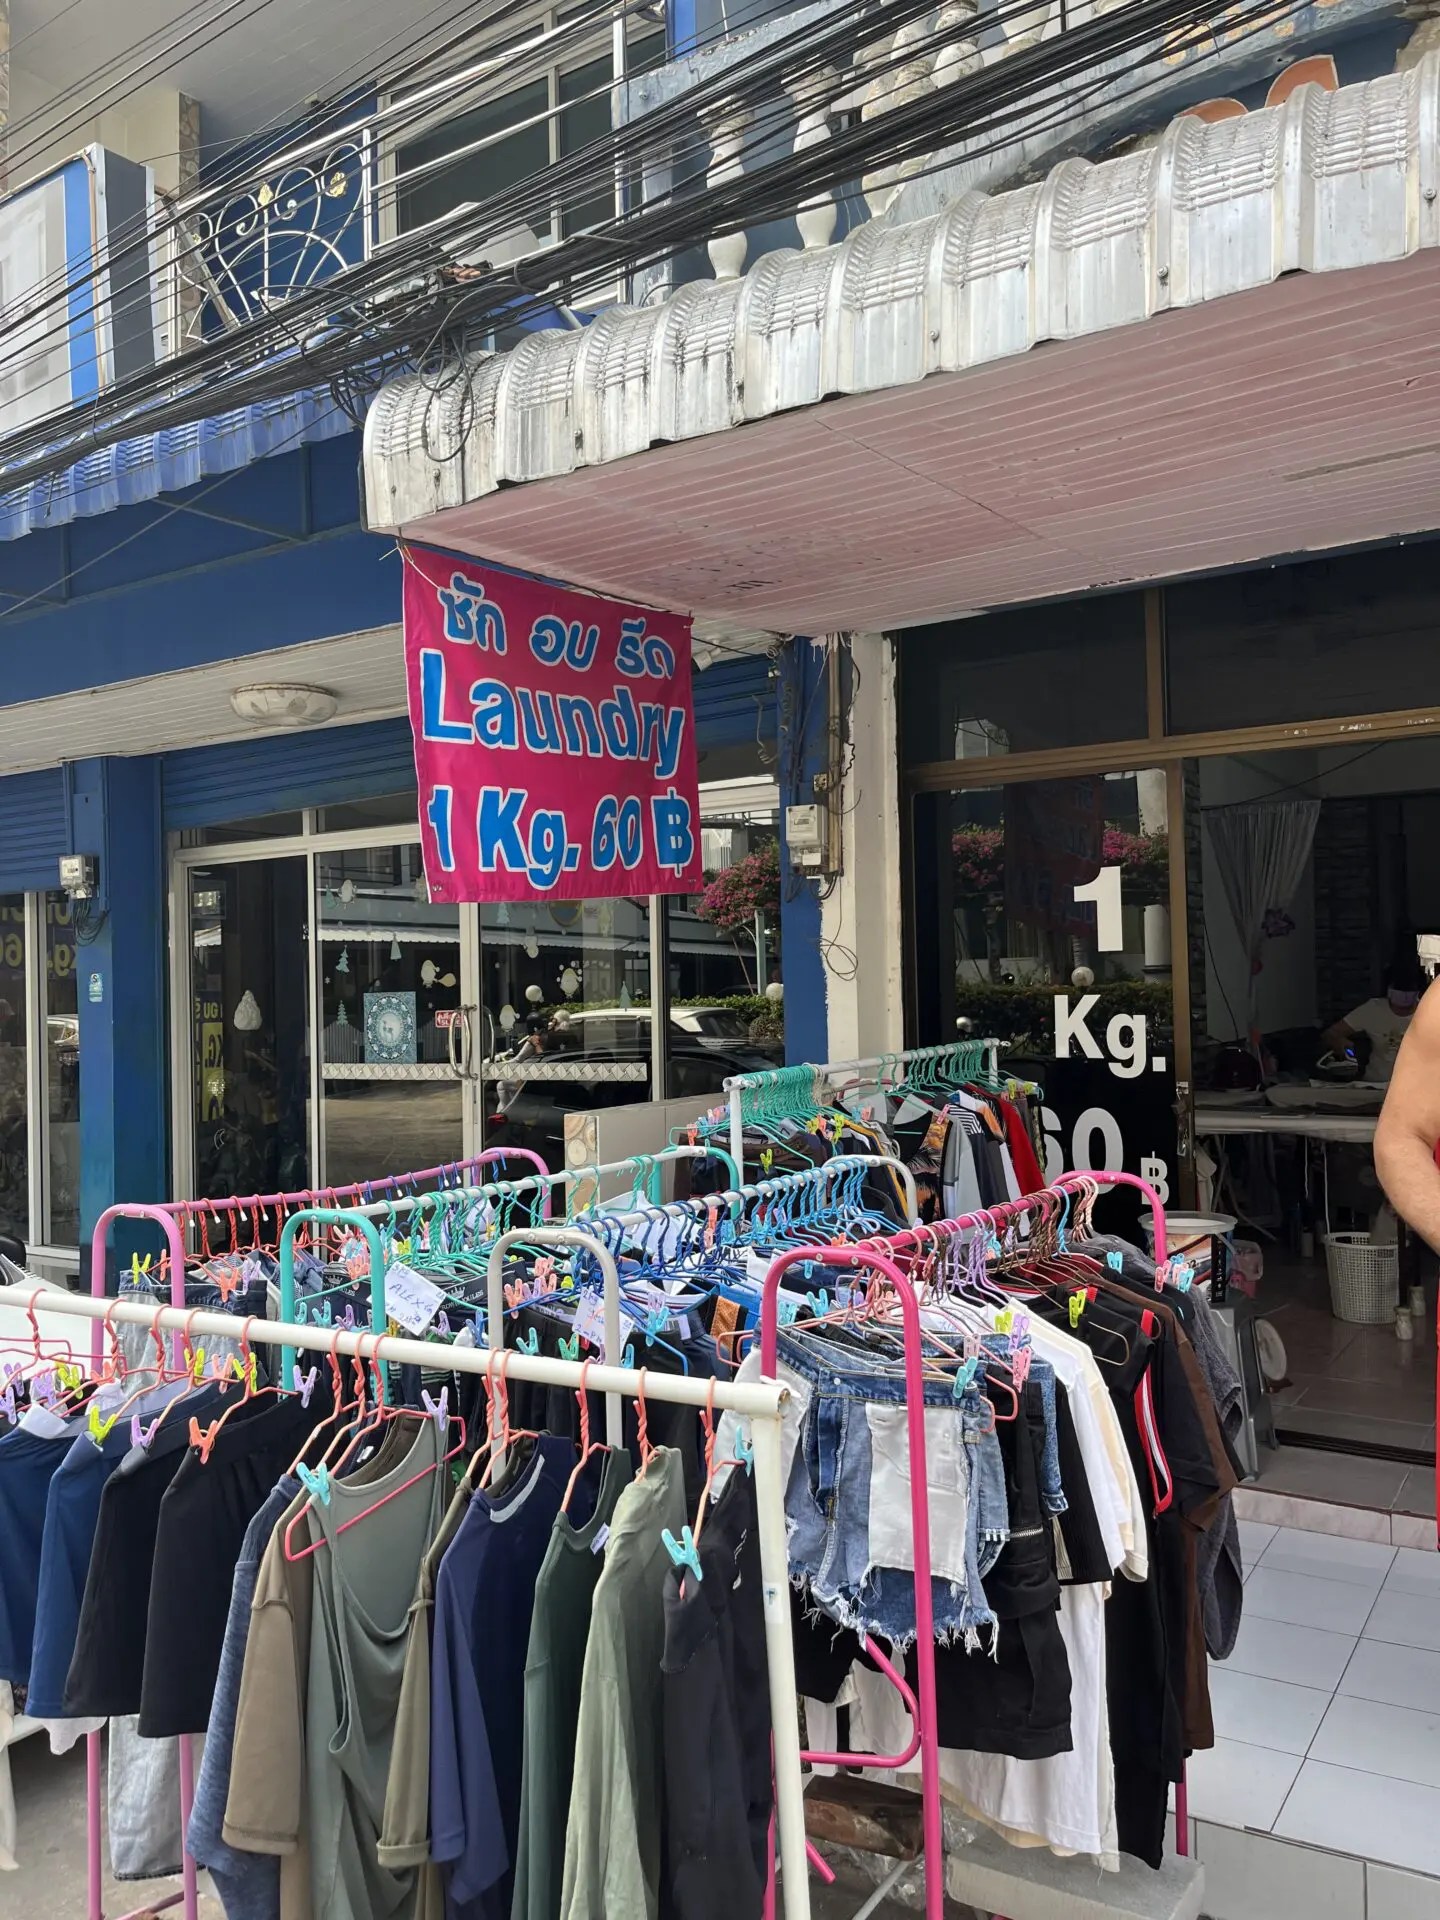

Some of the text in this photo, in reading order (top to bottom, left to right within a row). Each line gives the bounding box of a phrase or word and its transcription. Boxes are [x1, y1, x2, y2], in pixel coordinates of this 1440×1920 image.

[529, 614, 600, 672] อบ
[615, 616, 675, 680] รีด
[419, 647, 685, 780] Laundry
[428, 785, 455, 872] 1
[476, 785, 582, 891] Kg.
[591, 794, 643, 871] 60
[1073, 866, 1123, 952] 1
[1054, 994, 1166, 1079] Kg.
